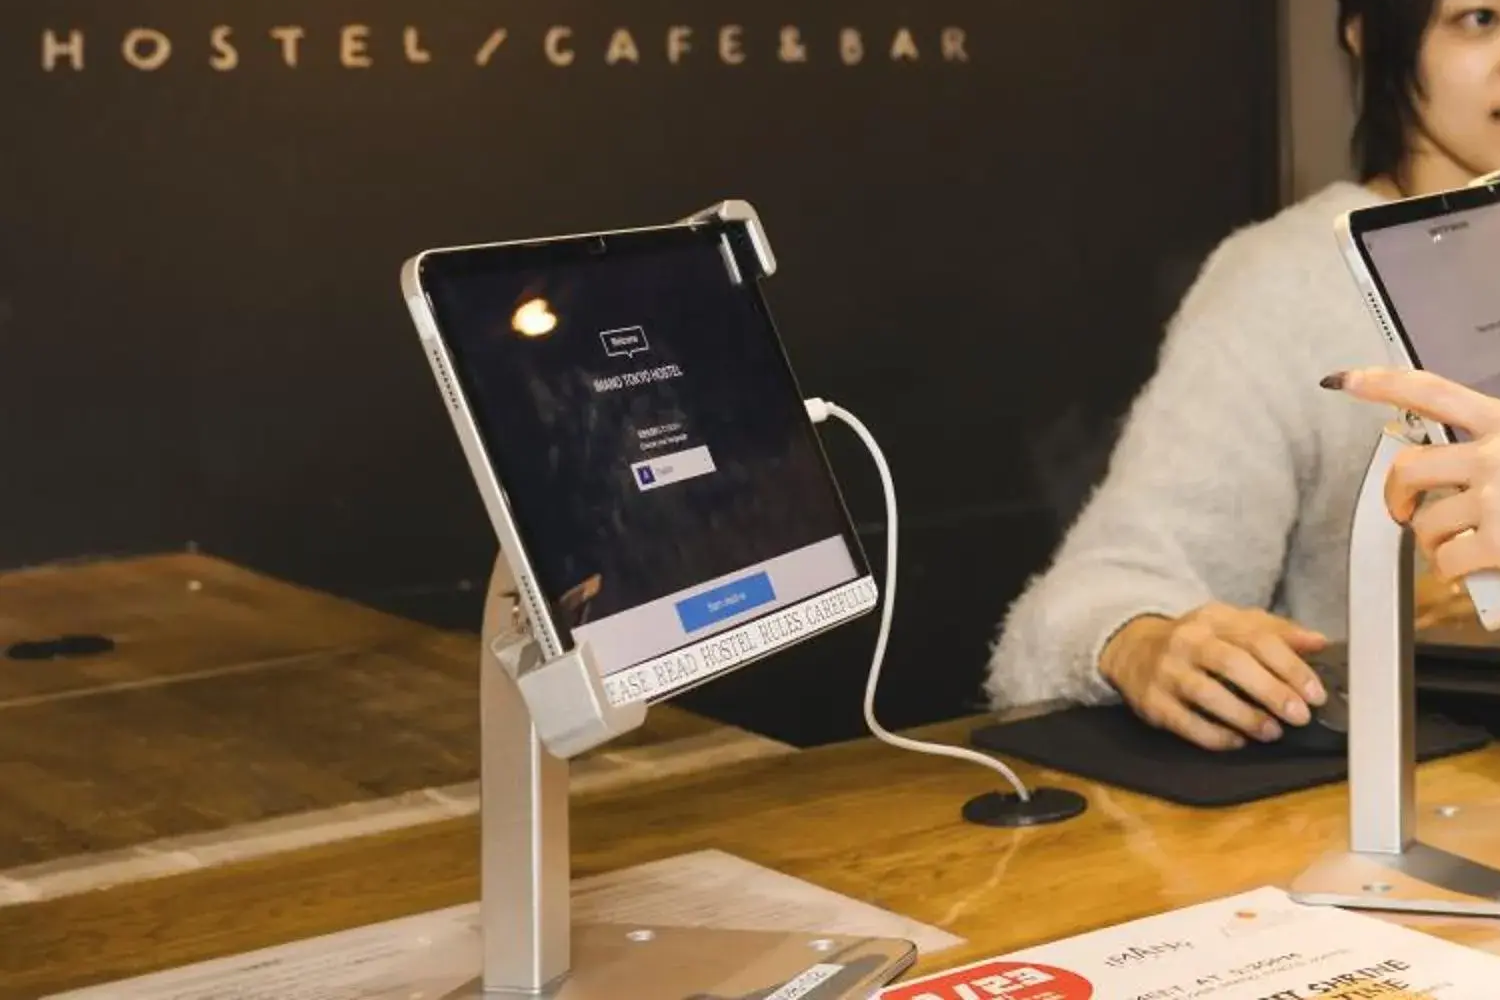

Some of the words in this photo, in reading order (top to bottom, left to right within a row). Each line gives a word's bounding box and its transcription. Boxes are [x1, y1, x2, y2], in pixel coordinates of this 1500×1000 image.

[655, 654, 699, 687] READ
[699, 630, 757, 668] HOSTEL
[758, 611, 803, 646] RULES
